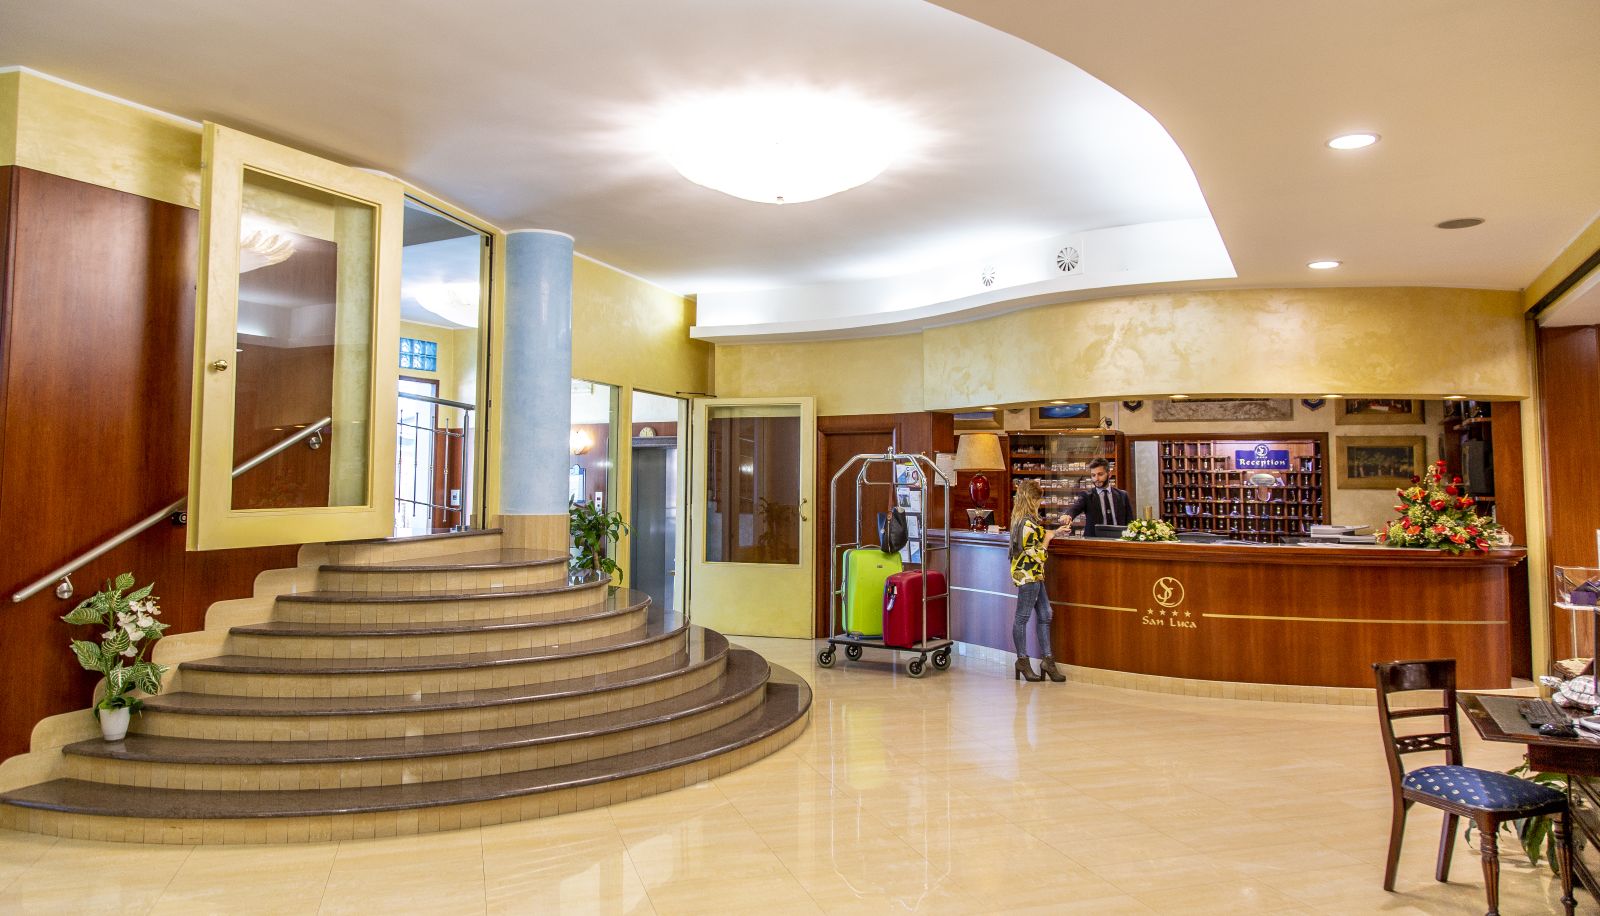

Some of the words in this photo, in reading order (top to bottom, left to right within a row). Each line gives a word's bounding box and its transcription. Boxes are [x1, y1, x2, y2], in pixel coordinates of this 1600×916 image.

[1239, 458, 1286, 467] Reception
[1142, 615, 1164, 626] San
[1169, 617, 1198, 629] Luca
